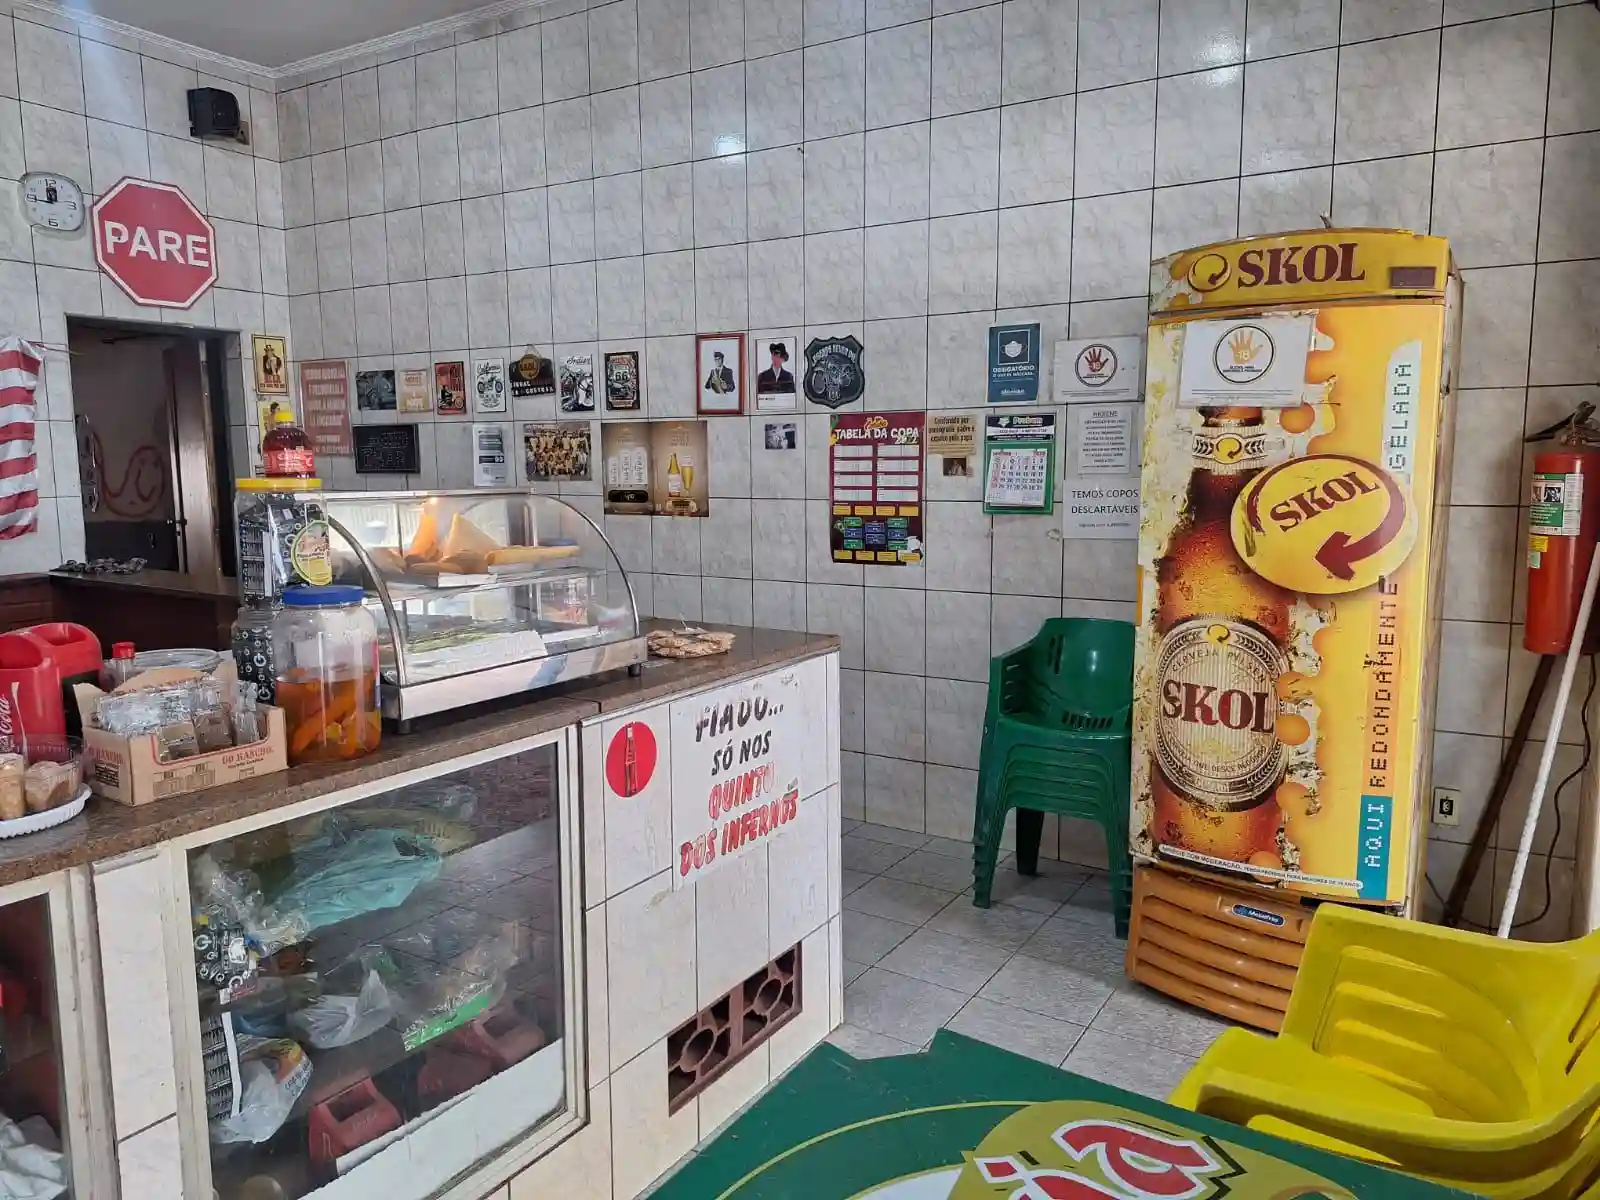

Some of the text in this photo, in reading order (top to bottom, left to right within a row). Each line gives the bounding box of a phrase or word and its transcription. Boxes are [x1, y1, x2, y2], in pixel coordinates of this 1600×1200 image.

[104, 220, 209, 268] PARE
[1237, 243, 1366, 290] SKOL
[615, 370, 629, 381] 66
[835, 427, 919, 440] TABELA DA COPA
[1389, 363, 1411, 471] GELADA
[1071, 489, 1139, 498] TEMOS COPOS
[1071, 504, 1139, 514] DESCARTÁVEIS
[1269, 471, 1380, 532] SKOL
[1171, 650, 1220, 672] CERVEJA
[1369, 575, 1399, 789] REDONDAMENTE
[1162, 679, 1275, 734] SKOL
[711, 730, 772, 776] SÓ NOS
[708, 761, 775, 820] QUINTO
[680, 788, 799, 877] DOS INFERNOS
[1364, 803, 1385, 868] AQUI
